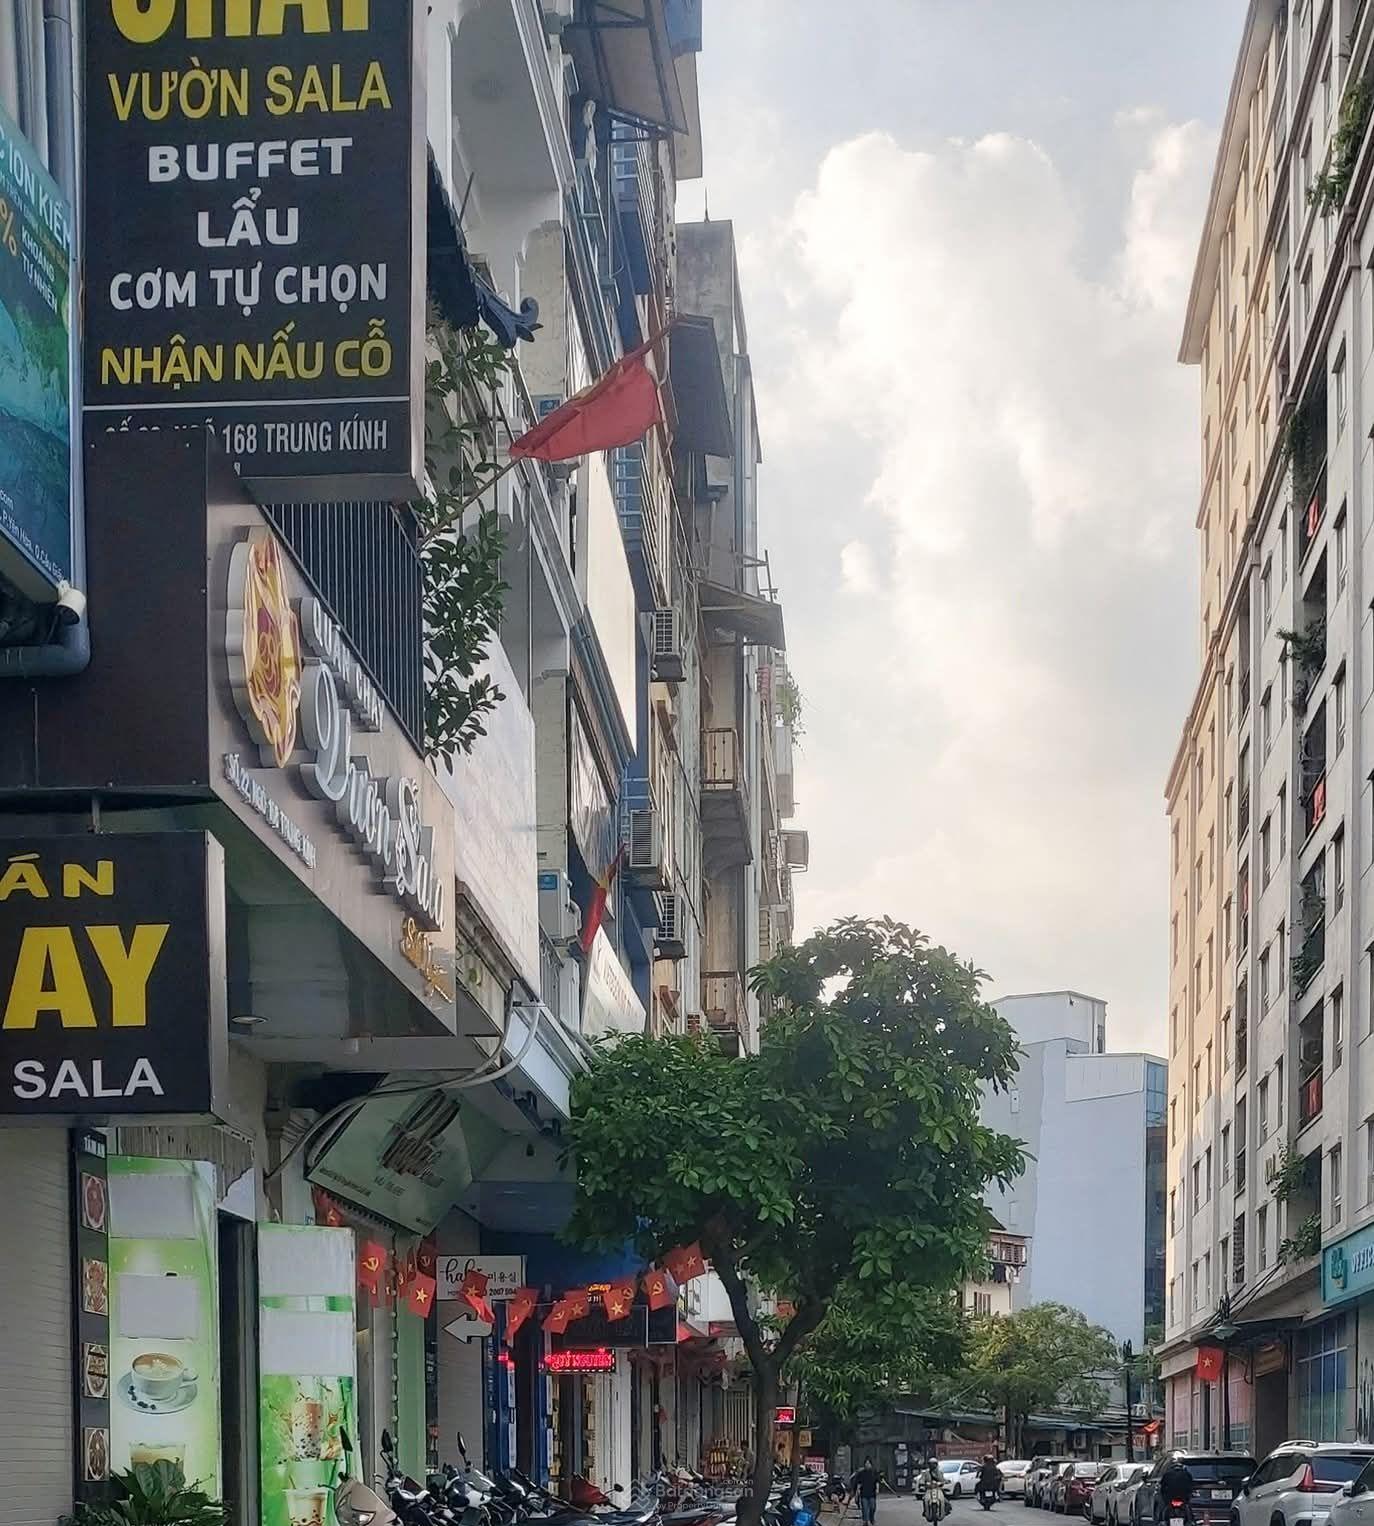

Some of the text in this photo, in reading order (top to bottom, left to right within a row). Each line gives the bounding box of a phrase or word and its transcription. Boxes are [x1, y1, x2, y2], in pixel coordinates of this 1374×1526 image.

[107, 56, 392, 121] VƯỜN SALA
[148, 137, 353, 183] BUFFET
[197, 187, 299, 248] LẨU
[109, 260, 388, 317] CƠM TỰ CHỌN
[101, 318, 393, 391] NHẬN NẤU CỖ
[222, 422, 258, 455] 168
[263, 419, 333, 453] TRUNG
[338, 413, 389, 450] KÍNH
[13, 1057, 164, 1099] SALA
